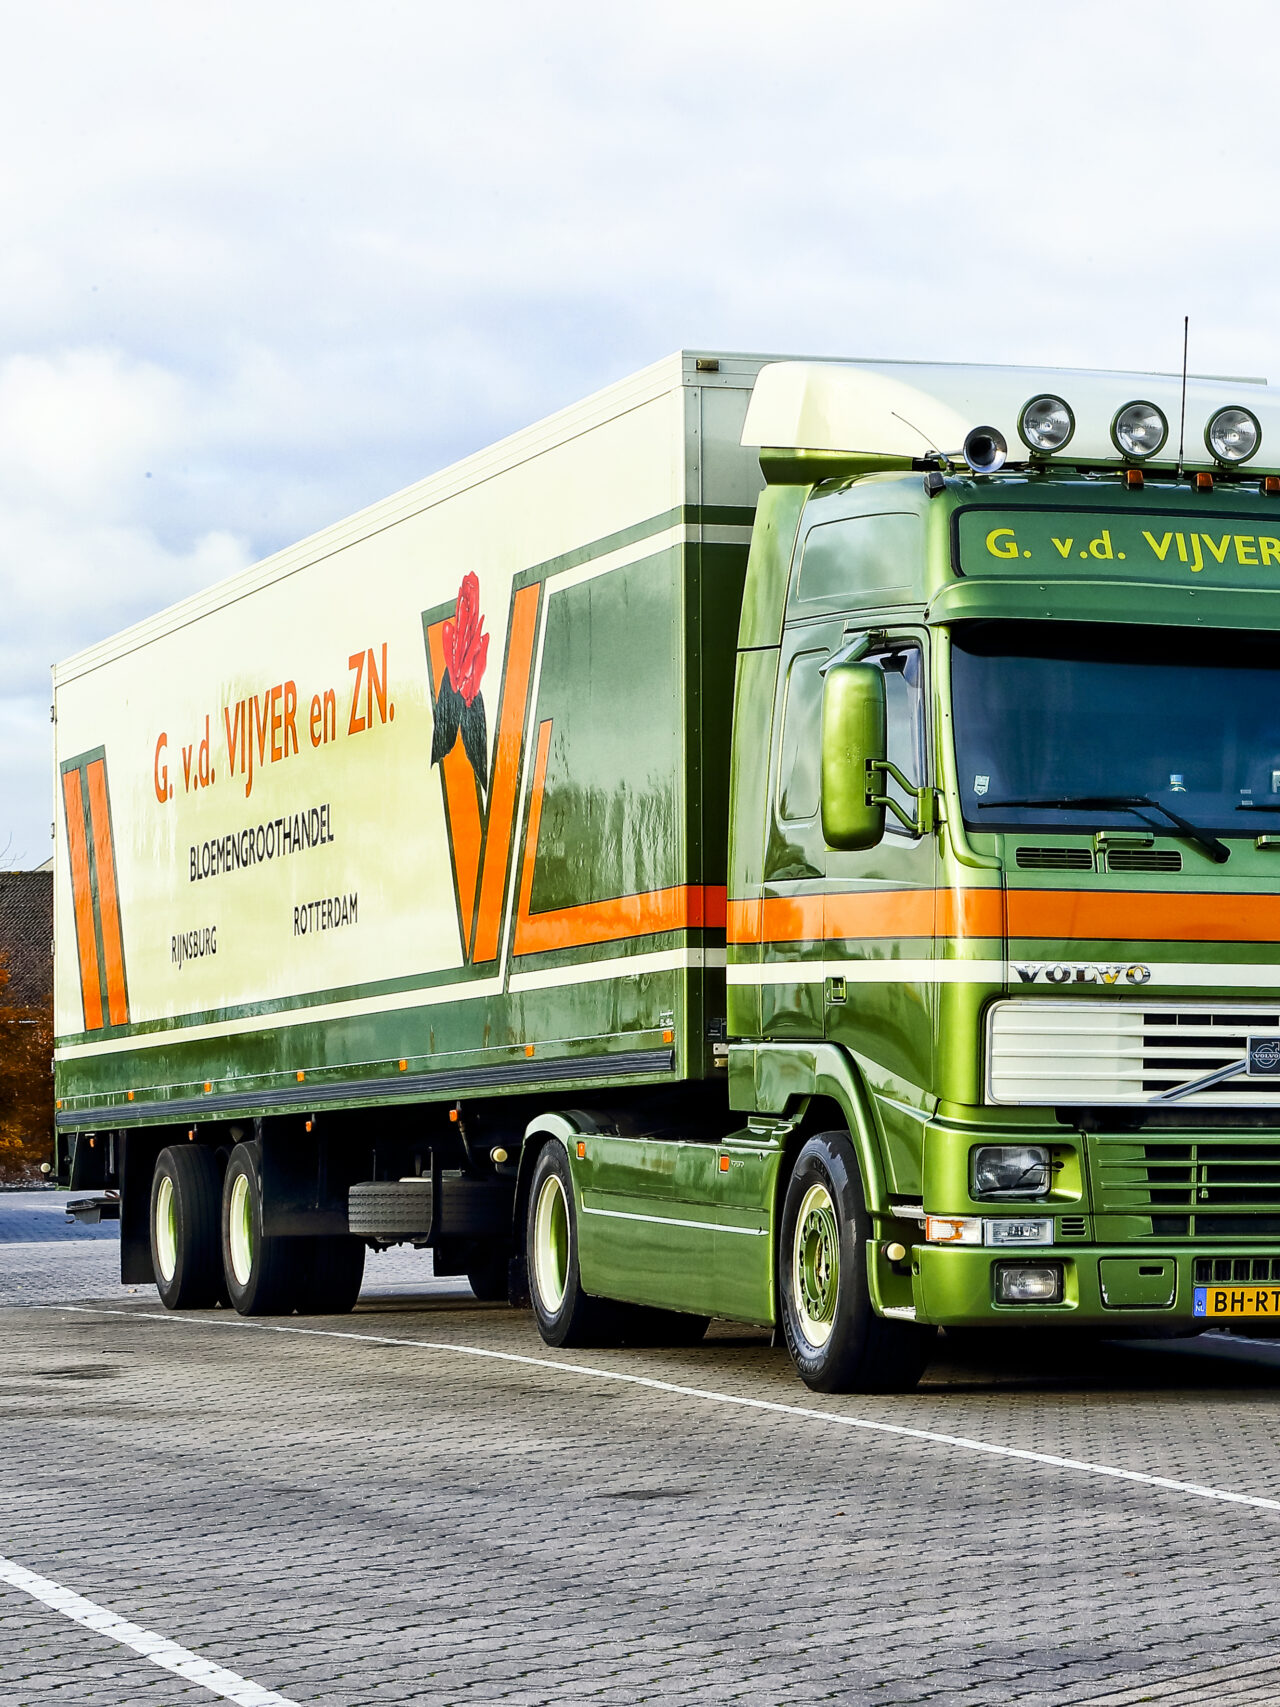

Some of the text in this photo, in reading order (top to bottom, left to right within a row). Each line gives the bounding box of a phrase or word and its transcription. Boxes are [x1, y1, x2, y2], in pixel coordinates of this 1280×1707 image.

[985, 528, 1032, 560] G.
[1050, 530, 1126, 561] v.d.
[154, 642, 395, 804] G. v.d. VIJVER en ZN.
[189, 803, 334, 882] BLOEMENGROOTHANDEL
[293, 892, 358, 936] ROTTERDAM
[171, 926, 217, 970] RIJNSBURG
[1011, 962, 1152, 985] VOLVO
